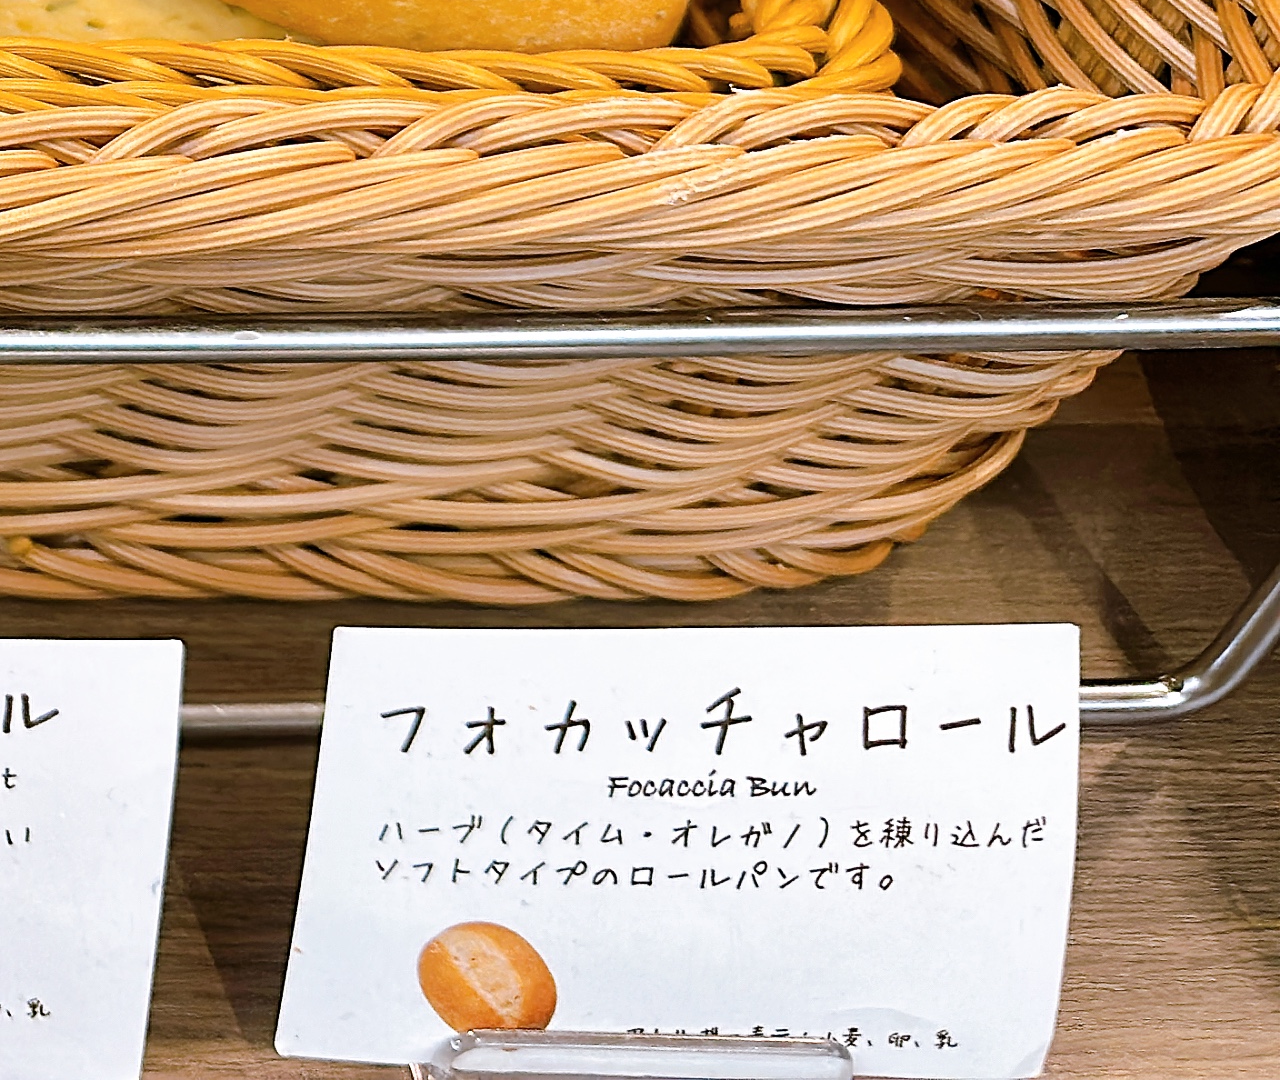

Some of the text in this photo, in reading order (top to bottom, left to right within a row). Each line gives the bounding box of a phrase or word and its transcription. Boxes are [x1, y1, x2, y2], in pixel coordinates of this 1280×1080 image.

[378, 685, 1068, 758] フォカッチャロール
[605, 768, 819, 800] Focaccia Bun
